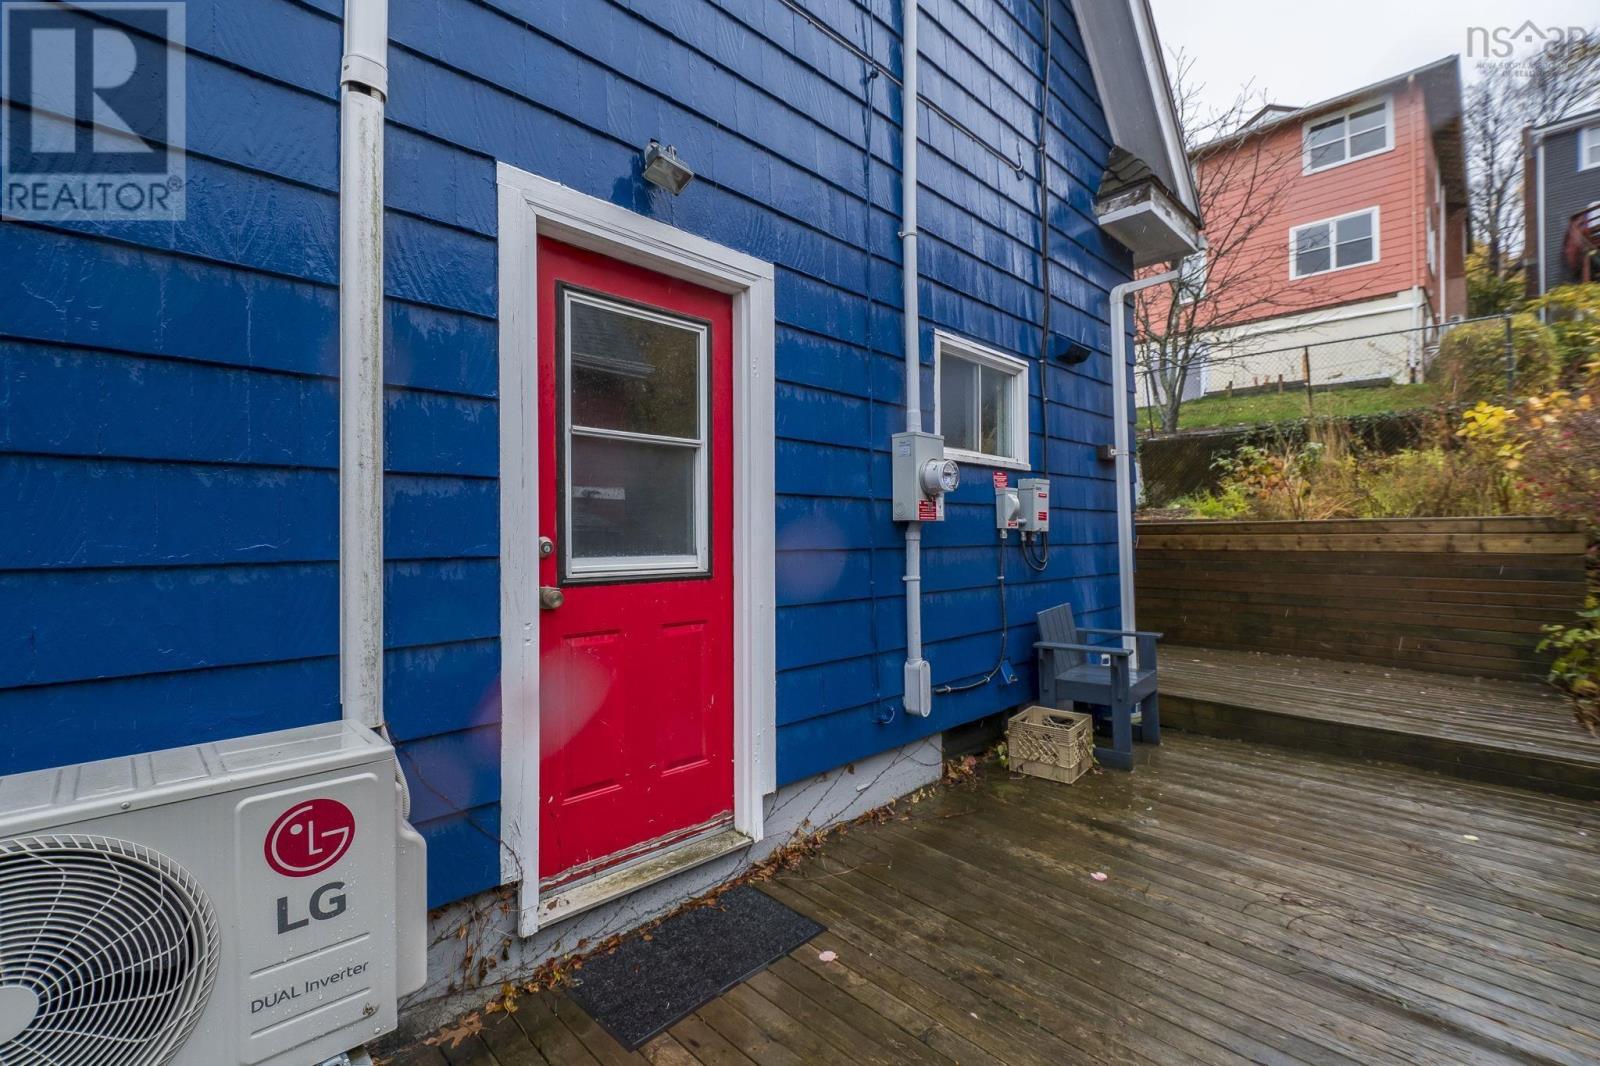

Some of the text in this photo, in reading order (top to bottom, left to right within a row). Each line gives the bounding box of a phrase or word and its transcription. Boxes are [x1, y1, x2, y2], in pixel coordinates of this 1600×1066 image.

[277, 881, 347, 935] LG
[251, 961, 369, 1014] DUAL Inverter
